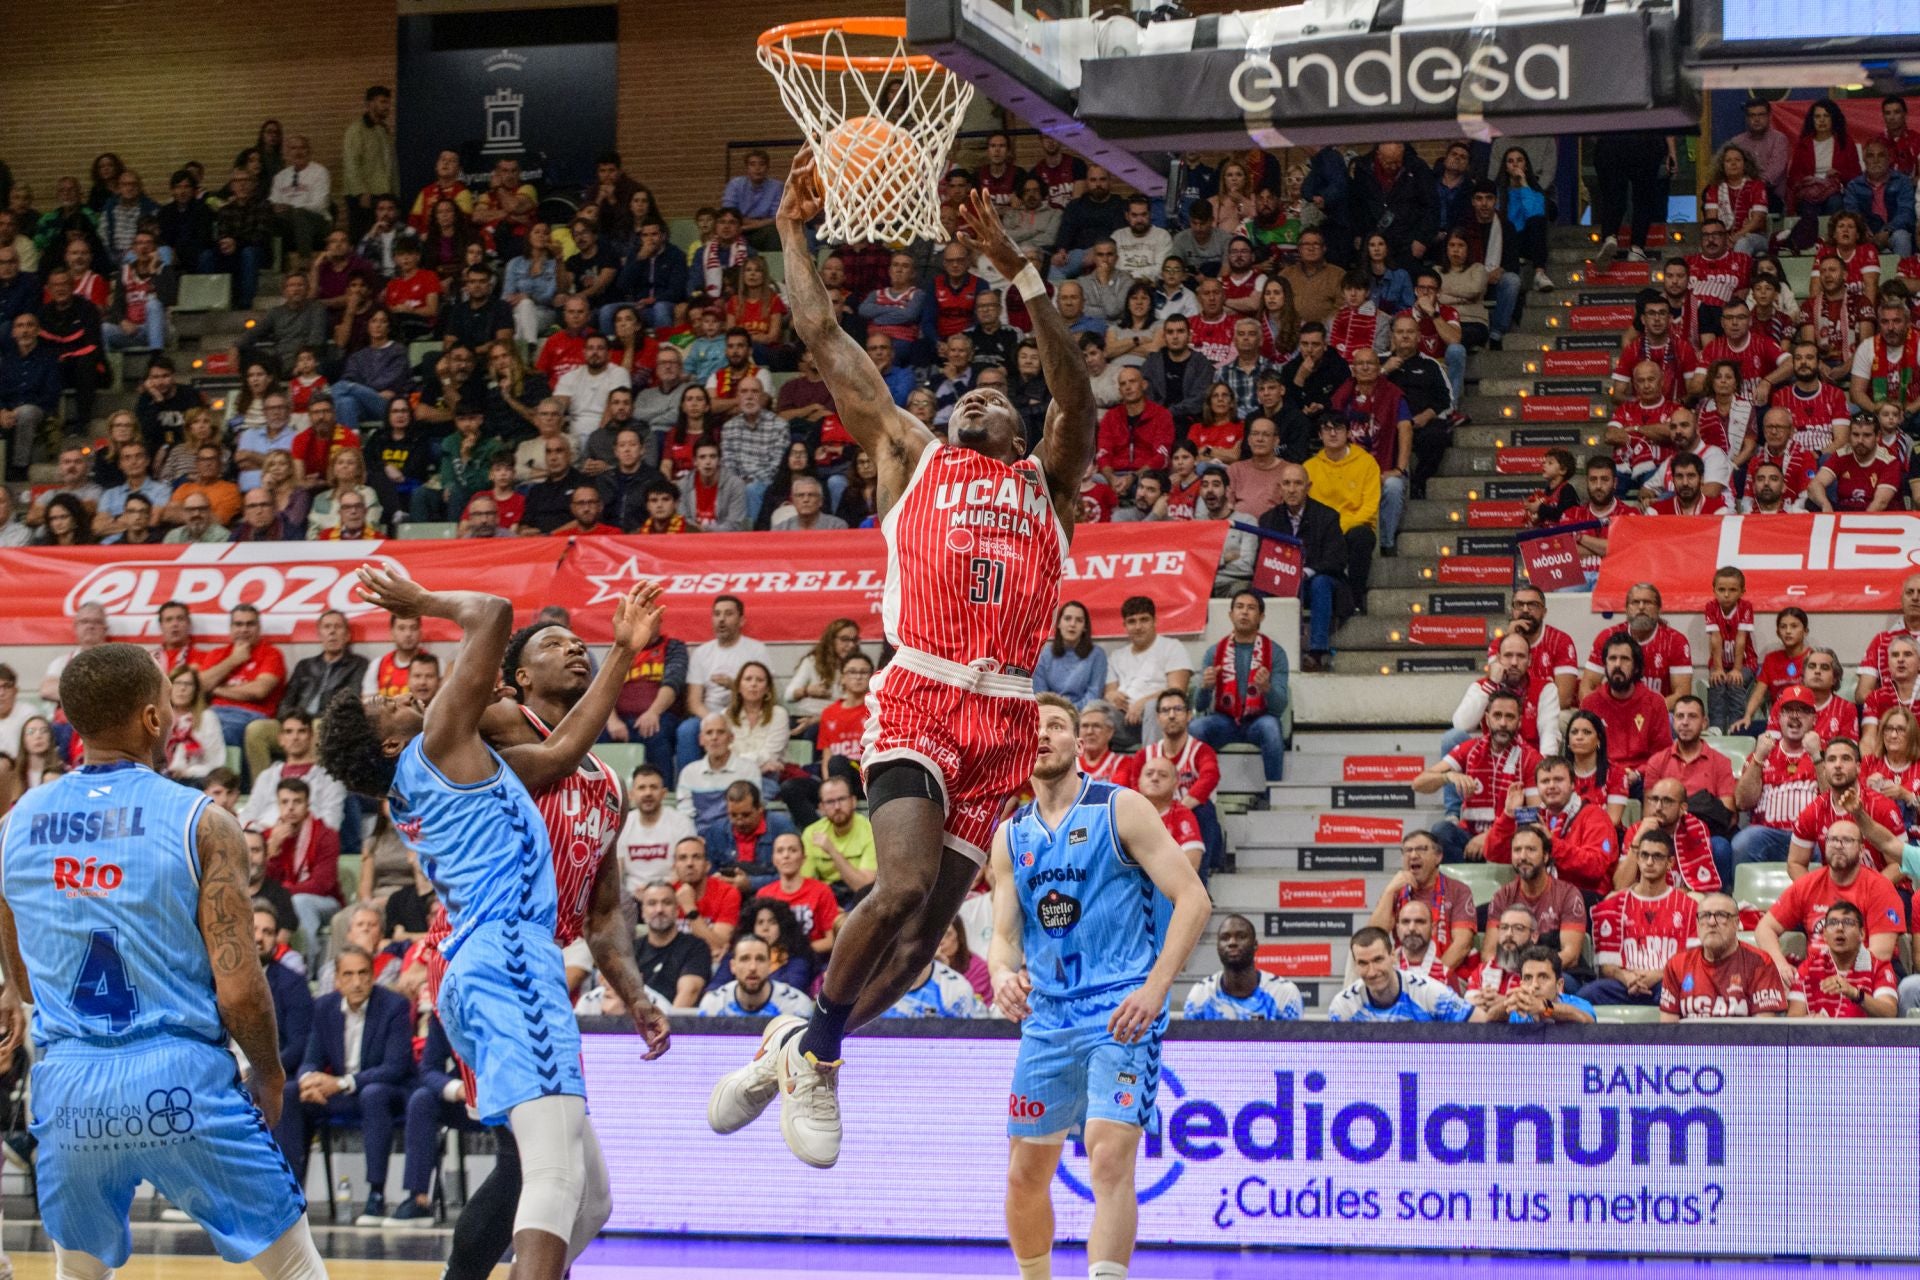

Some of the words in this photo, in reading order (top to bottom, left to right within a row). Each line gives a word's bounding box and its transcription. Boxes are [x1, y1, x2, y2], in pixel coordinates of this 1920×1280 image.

[1229, 27, 1570, 113] endesa
[935, 477, 1048, 526] UCAM
[951, 510, 1031, 537] MURCIA
[1059, 551, 1186, 580] ANTE
[1263, 556, 1297, 576] MÓDULO
[1532, 552, 1573, 569] MÓDULO
[1550, 568, 1563, 580] 10
[666, 570, 886, 594] ESTRELL
[970, 558, 1006, 605] 31
[1273, 575, 1281, 586] 9
[30, 807, 145, 846] RUSSELL
[54, 856, 123, 891] Río
[69, 927, 139, 1034] 4
[1583, 1065, 1724, 1095] BANCO
[56, 1103, 142, 1119] DEPUTACIÓN
[56, 1117, 72, 1130] DE
[75, 1115, 143, 1139] LUGO
[59, 1134, 196, 1152] VICEPRESIDENCIA
[1213, 1176, 1382, 1229] ¿Cuáles
[1398, 1186, 1473, 1221] son
[1491, 1182, 1551, 1222] tus
[1568, 1181, 1725, 1224] metas?
